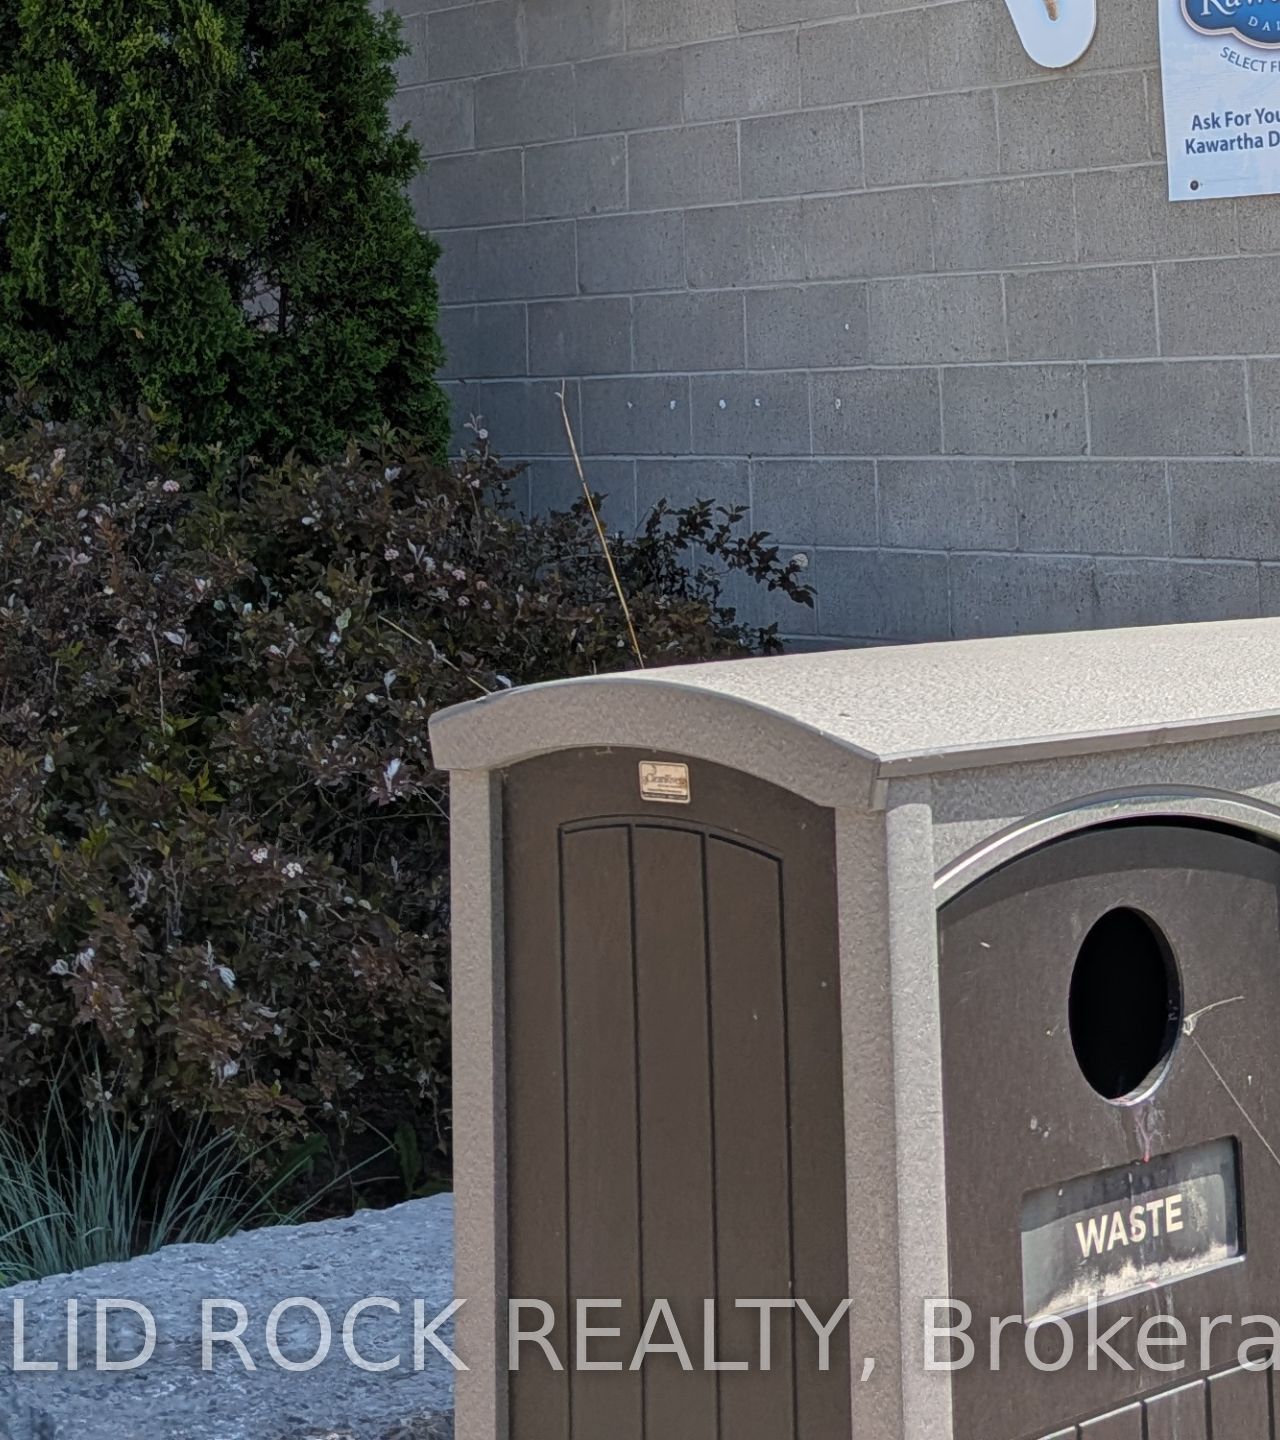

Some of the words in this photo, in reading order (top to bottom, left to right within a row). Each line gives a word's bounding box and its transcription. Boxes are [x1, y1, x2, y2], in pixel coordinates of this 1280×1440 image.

[1220, 46, 1267, 73] SELECT
[1191, 111, 1221, 131] Ask
[1225, 111, 1251, 127] For
[1185, 133, 1263, 155] Kawartha
[1075, 1194, 1183, 1258] WASTE
